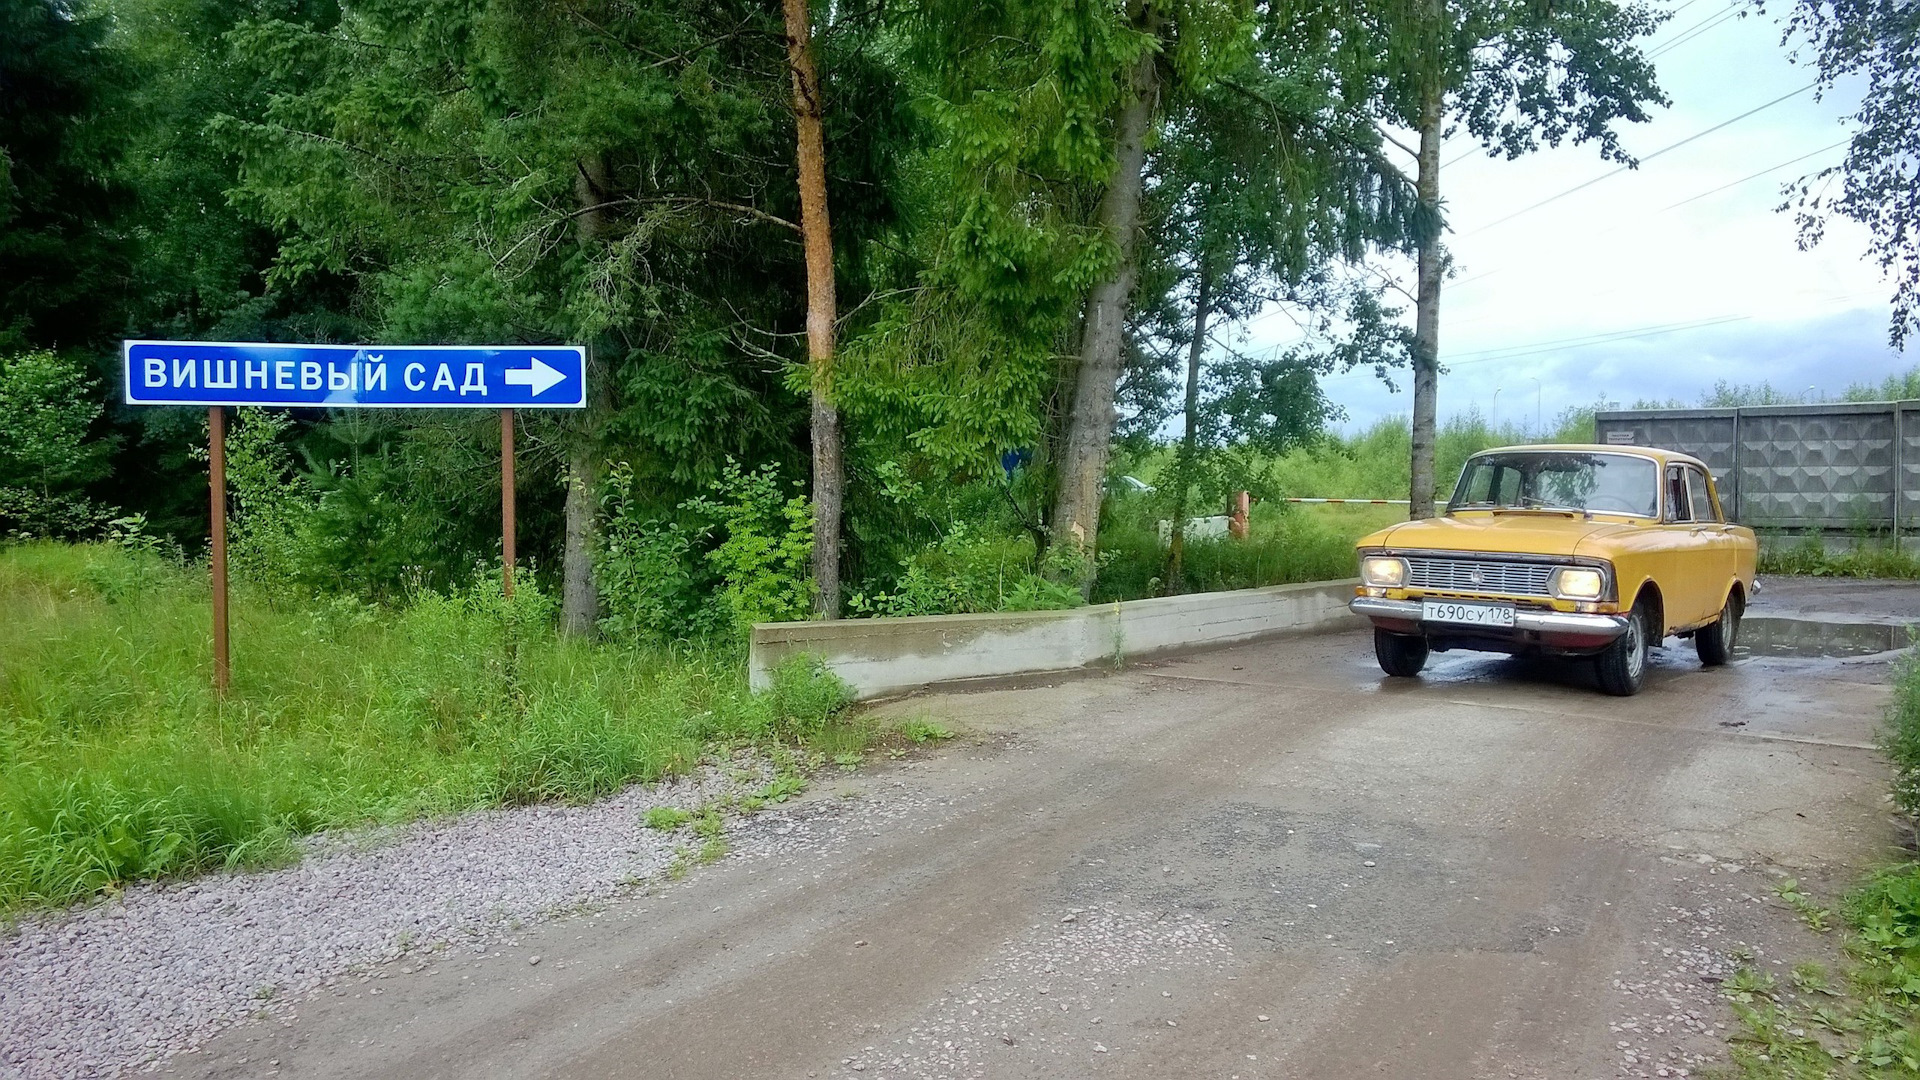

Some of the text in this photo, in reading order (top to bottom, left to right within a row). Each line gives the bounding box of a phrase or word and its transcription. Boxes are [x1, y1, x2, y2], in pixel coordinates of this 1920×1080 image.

[144, 354, 488, 396] ВИШНЕВЫЙ САД
[1488, 607, 1510, 620] 178
